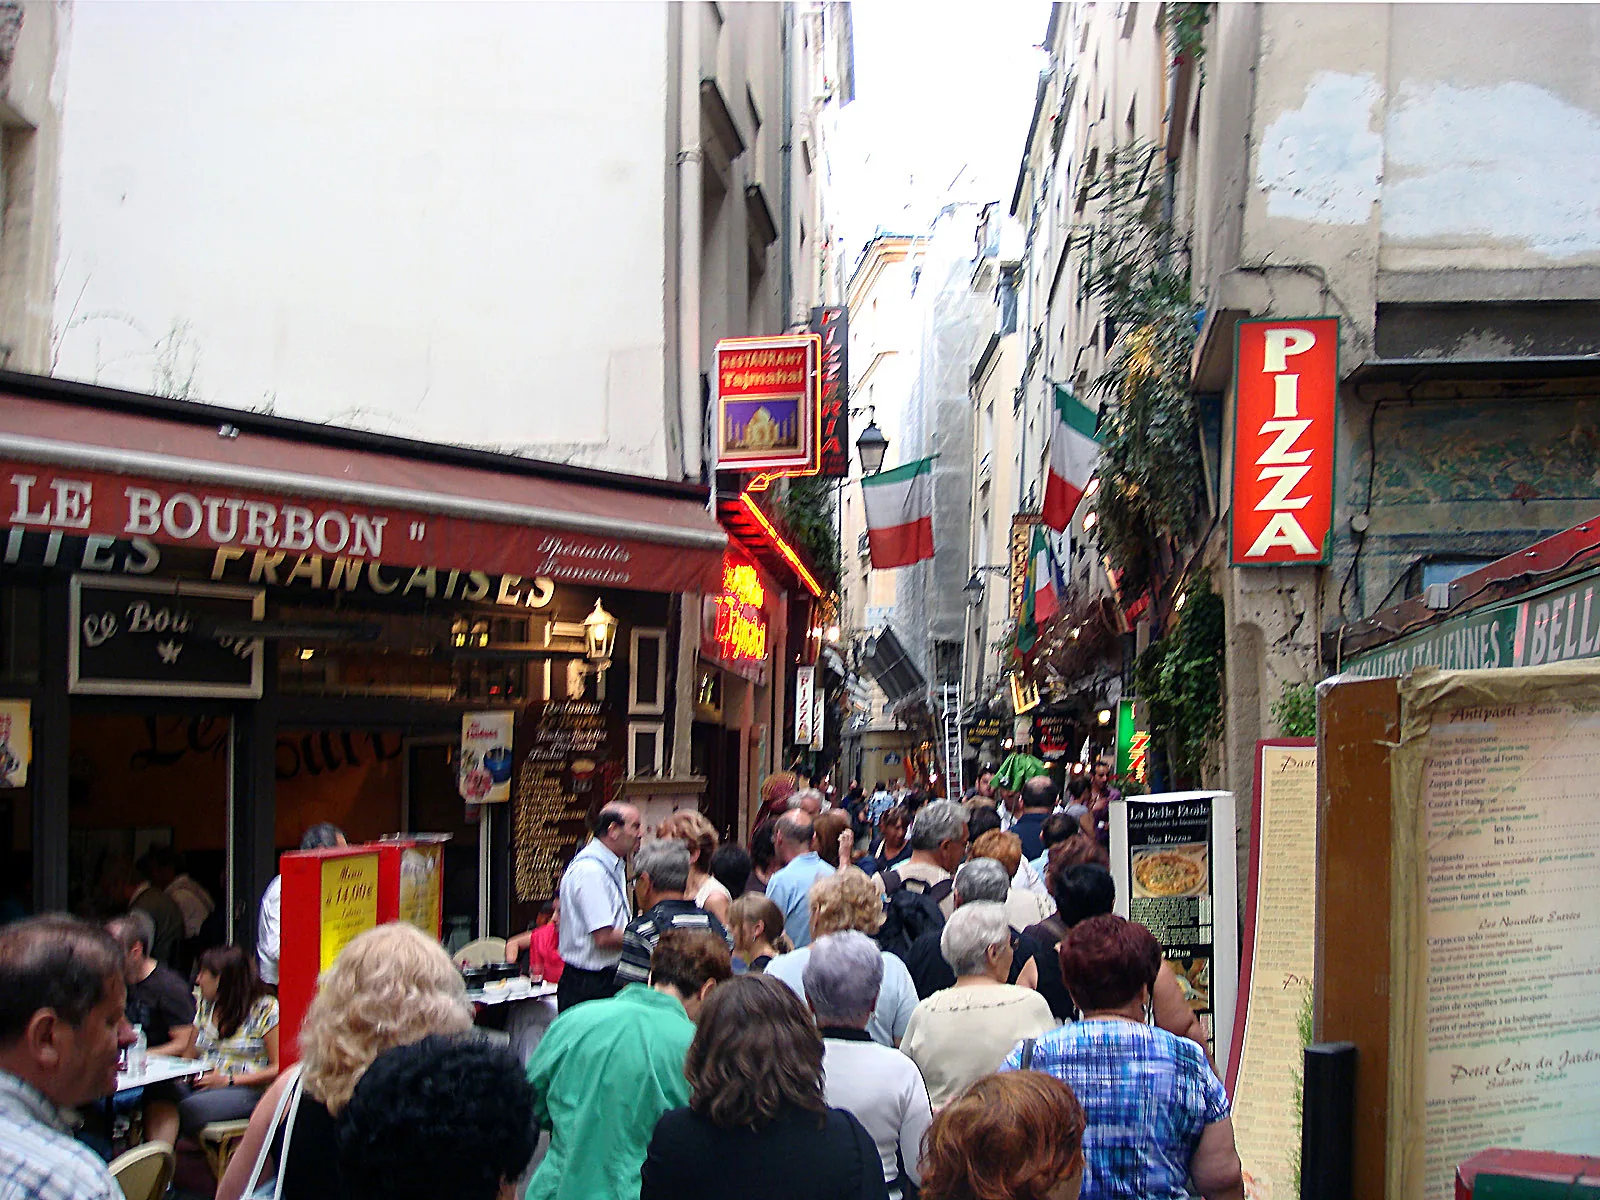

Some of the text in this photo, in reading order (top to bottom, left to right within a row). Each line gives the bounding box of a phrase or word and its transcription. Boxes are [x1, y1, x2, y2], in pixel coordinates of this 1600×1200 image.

[721, 351, 804, 369] RESTAURANT
[721, 369, 804, 390] Tajmahal
[1244, 328, 1319, 557] PIZZA
[9, 474, 93, 529] LE
[124, 486, 388, 558] BOURBON
[1450, 704, 1518, 723] Antipasti
[1147, 806, 1175, 819] Belle
[1494, 837, 1504, 846] les
[1499, 914, 1544, 928] Nouvelles
[1450, 1063, 1491, 1085] Petit
[1496, 1056, 1532, 1074] Coin
[1535, 1056, 1554, 1068] du
